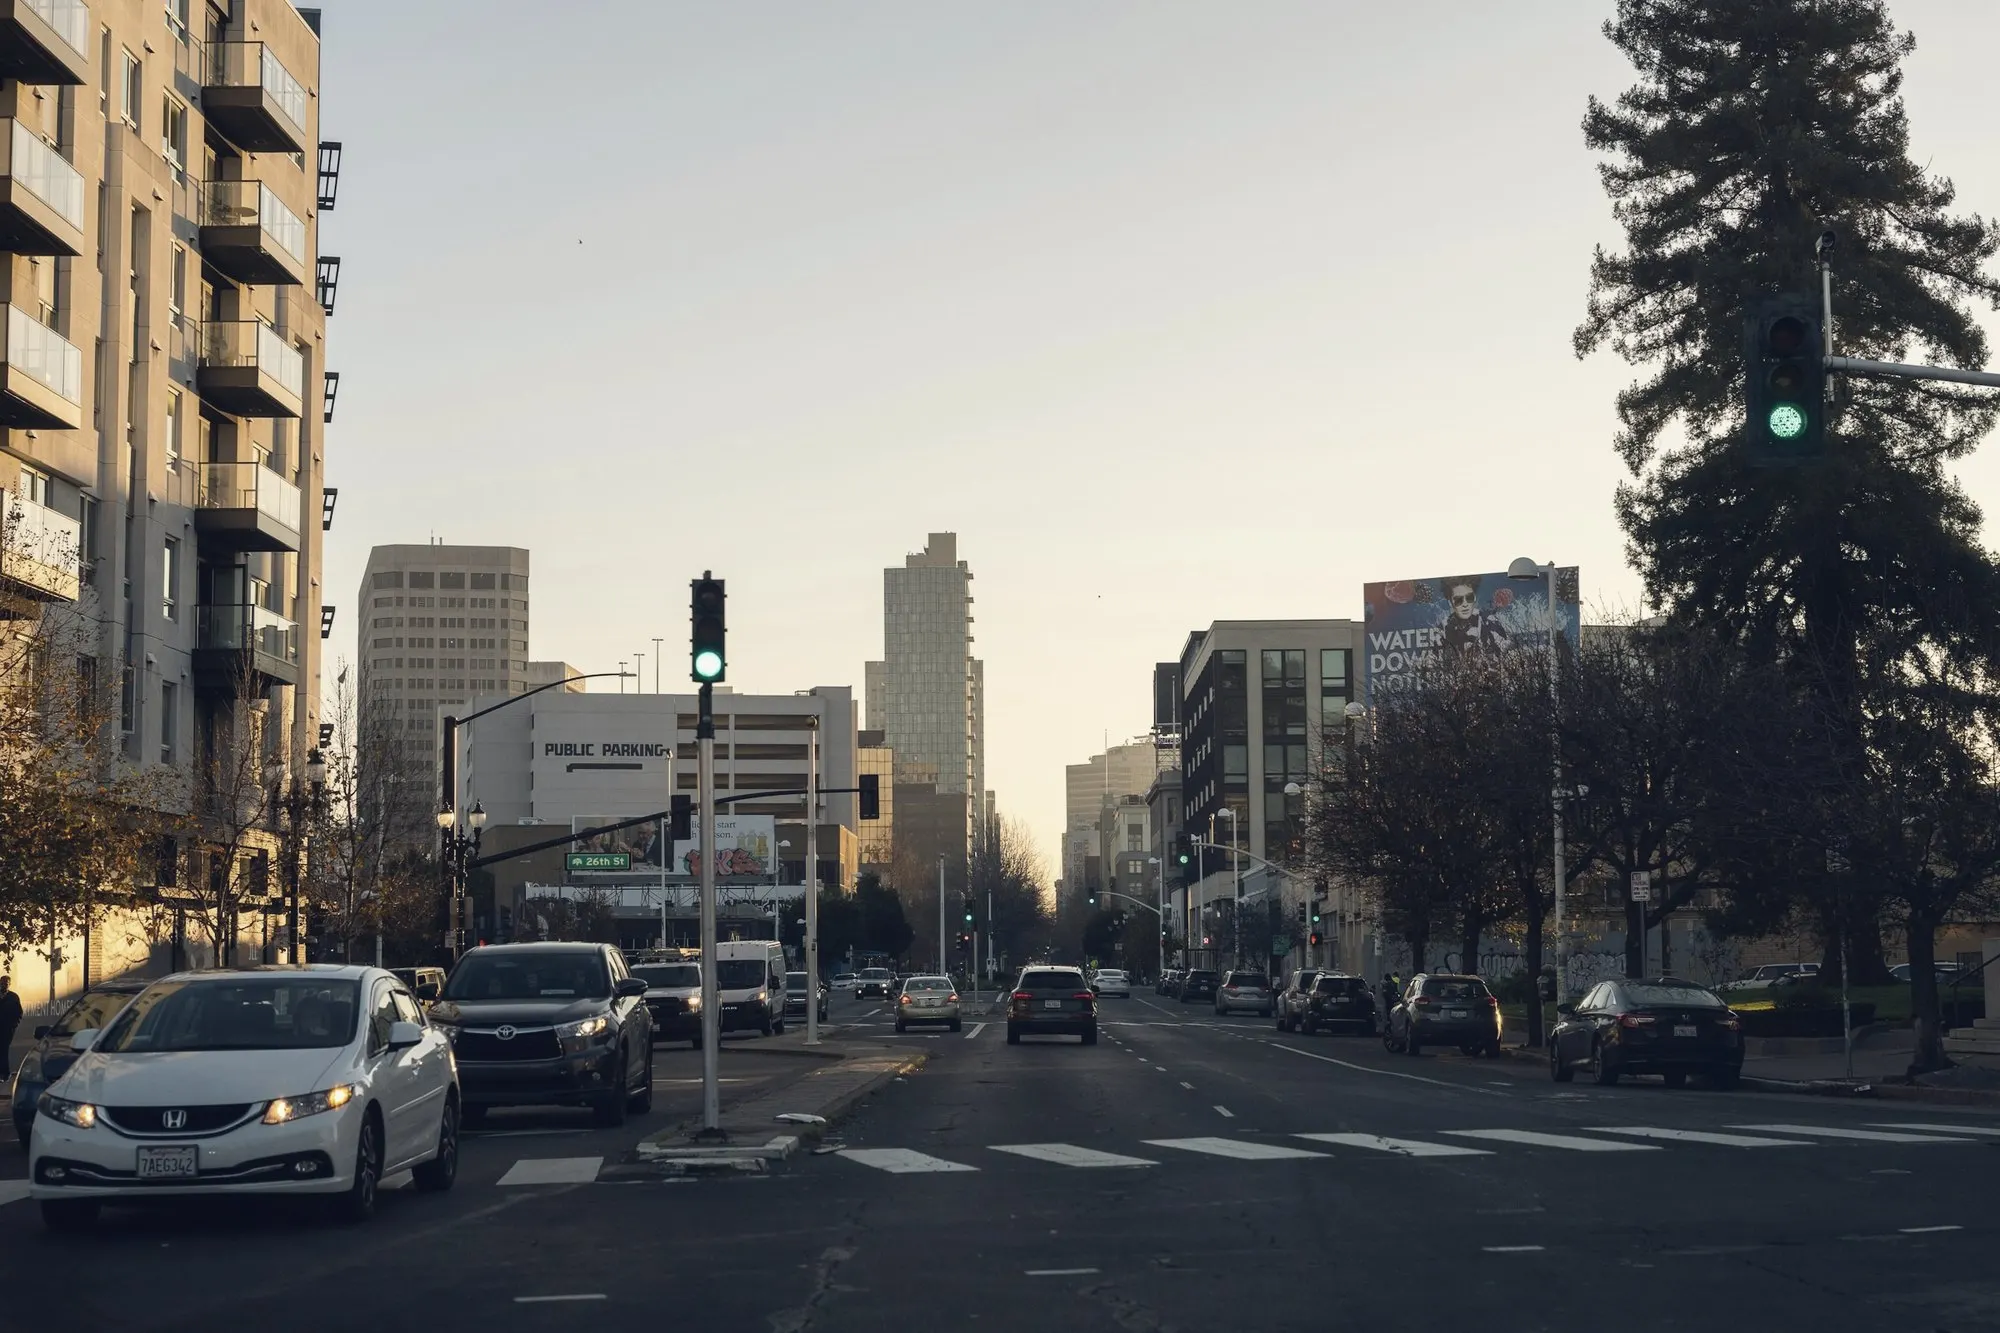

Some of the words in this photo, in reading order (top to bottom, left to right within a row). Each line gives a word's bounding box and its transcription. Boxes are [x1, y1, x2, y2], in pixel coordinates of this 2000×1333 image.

[1368, 627, 1443, 651] WATER
[545, 743, 594, 756] PUBLIC
[602, 743, 663, 756] PARKING
[586, 857, 610, 866] 26th
[613, 857, 624, 866] St
[141, 1157, 193, 1173] 7AEG342
